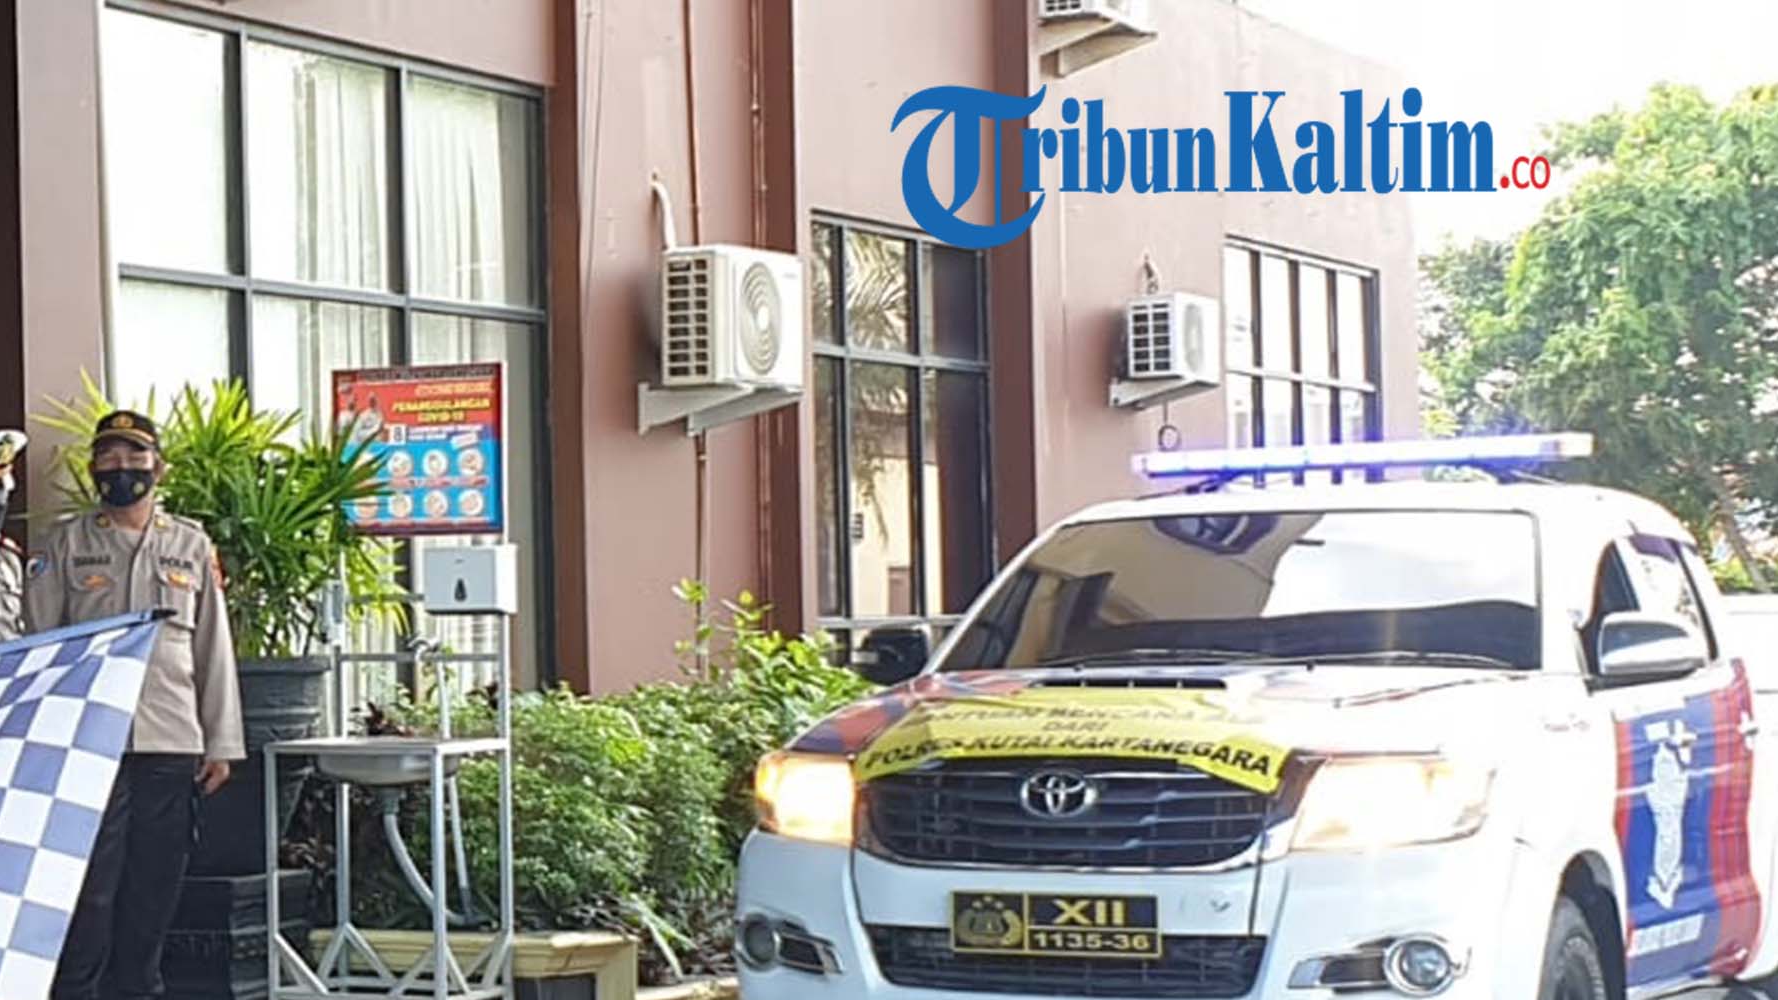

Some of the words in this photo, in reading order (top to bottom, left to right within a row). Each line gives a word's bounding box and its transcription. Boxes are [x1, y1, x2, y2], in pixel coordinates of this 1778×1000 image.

[1042, 721, 1109, 732] DARI
[1056, 736, 1271, 776] KARTANEGARA
[1052, 899, 1124, 926] XII
[1033, 932, 1151, 951] 1135-36
